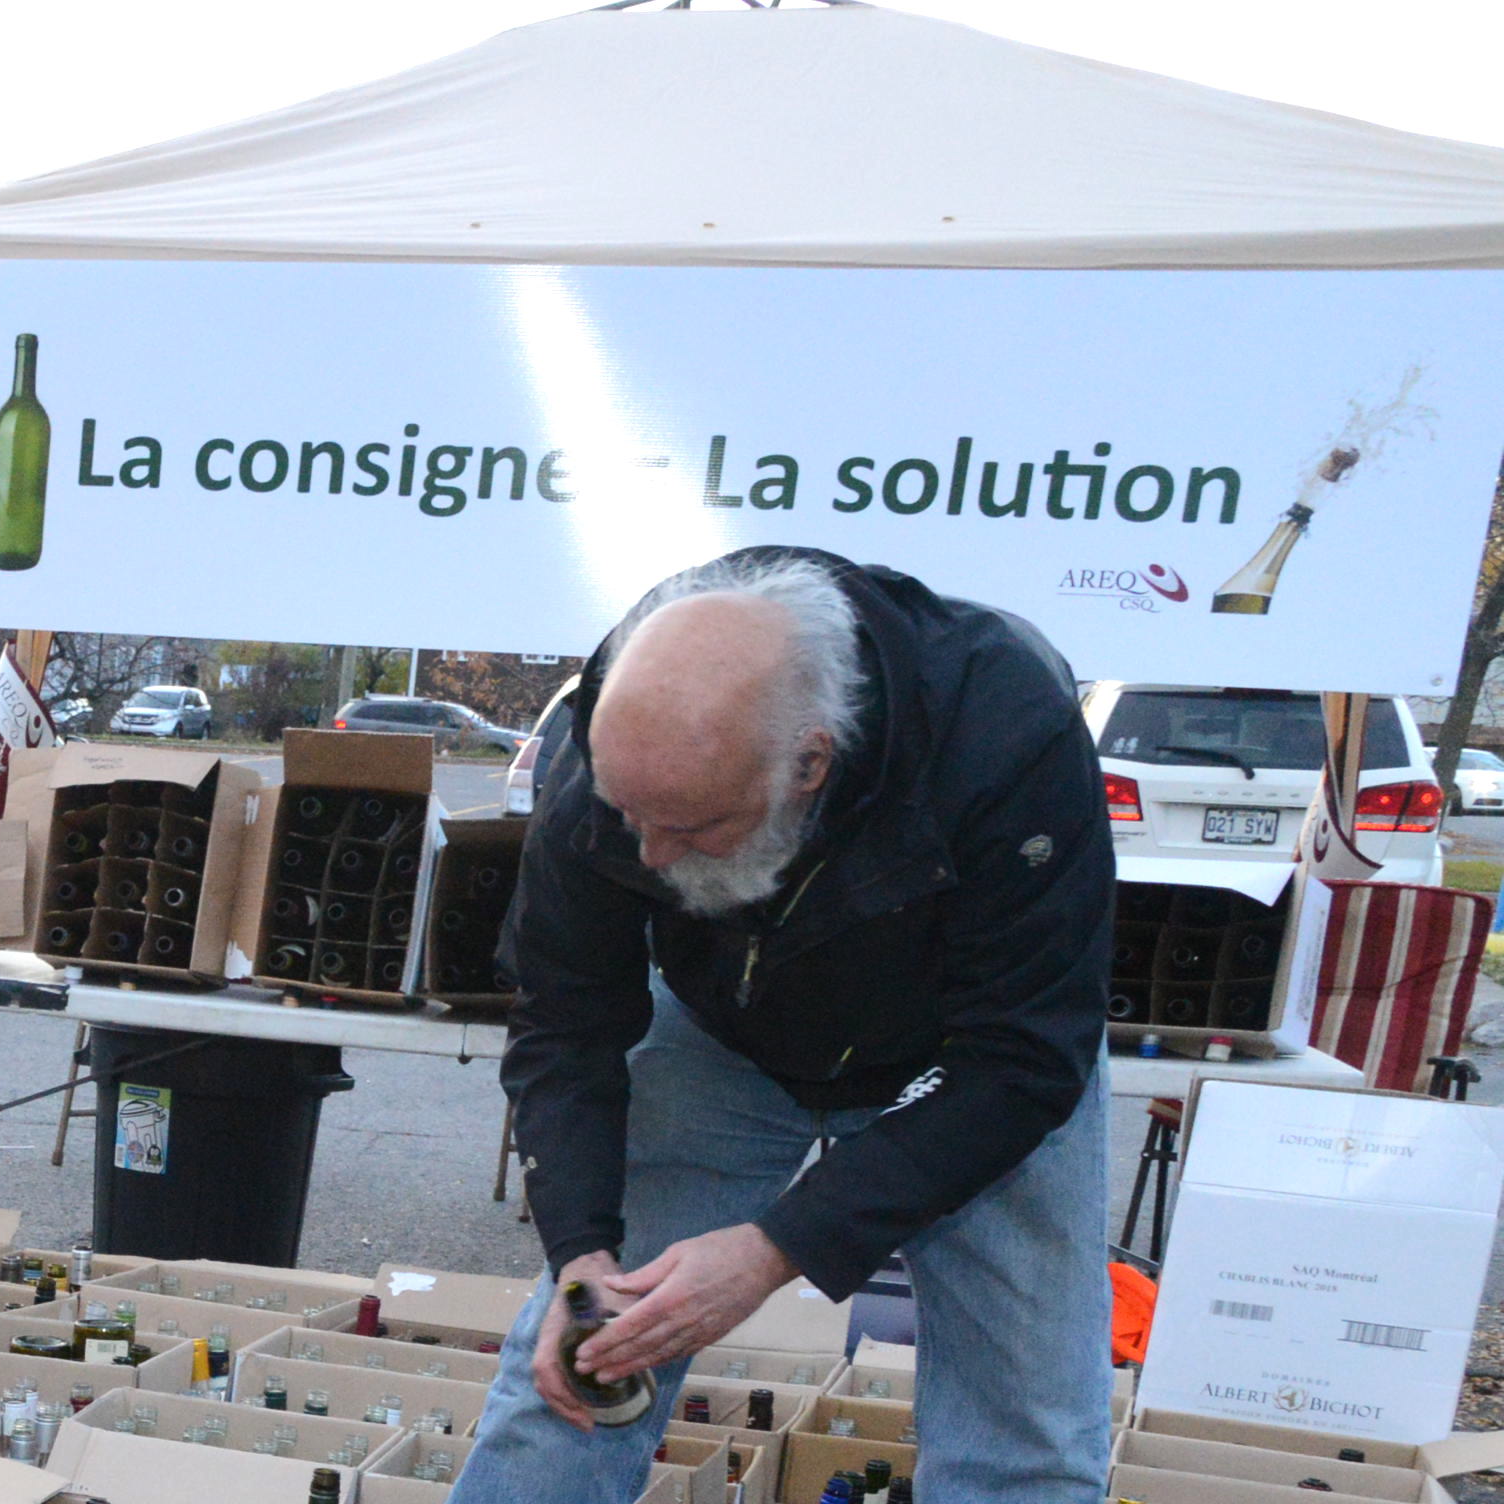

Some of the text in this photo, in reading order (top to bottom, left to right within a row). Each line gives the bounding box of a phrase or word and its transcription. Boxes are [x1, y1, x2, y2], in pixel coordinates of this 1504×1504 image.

[77, 418, 163, 489] La
[194, 423, 580, 517] consigne
[702, 434, 799, 510] La
[831, 435, 1242, 524] solution
[1057, 567, 1139, 595] AREQ
[1118, 597, 1160, 613] CSQ
[1206, 818, 1274, 834] 021 SYW
[1291, 1264, 1379, 1284] SAQ Montréal
[1272, 1278, 1311, 1291] BLANC
[1200, 1382, 1384, 1420] ALBERT BICHOT
